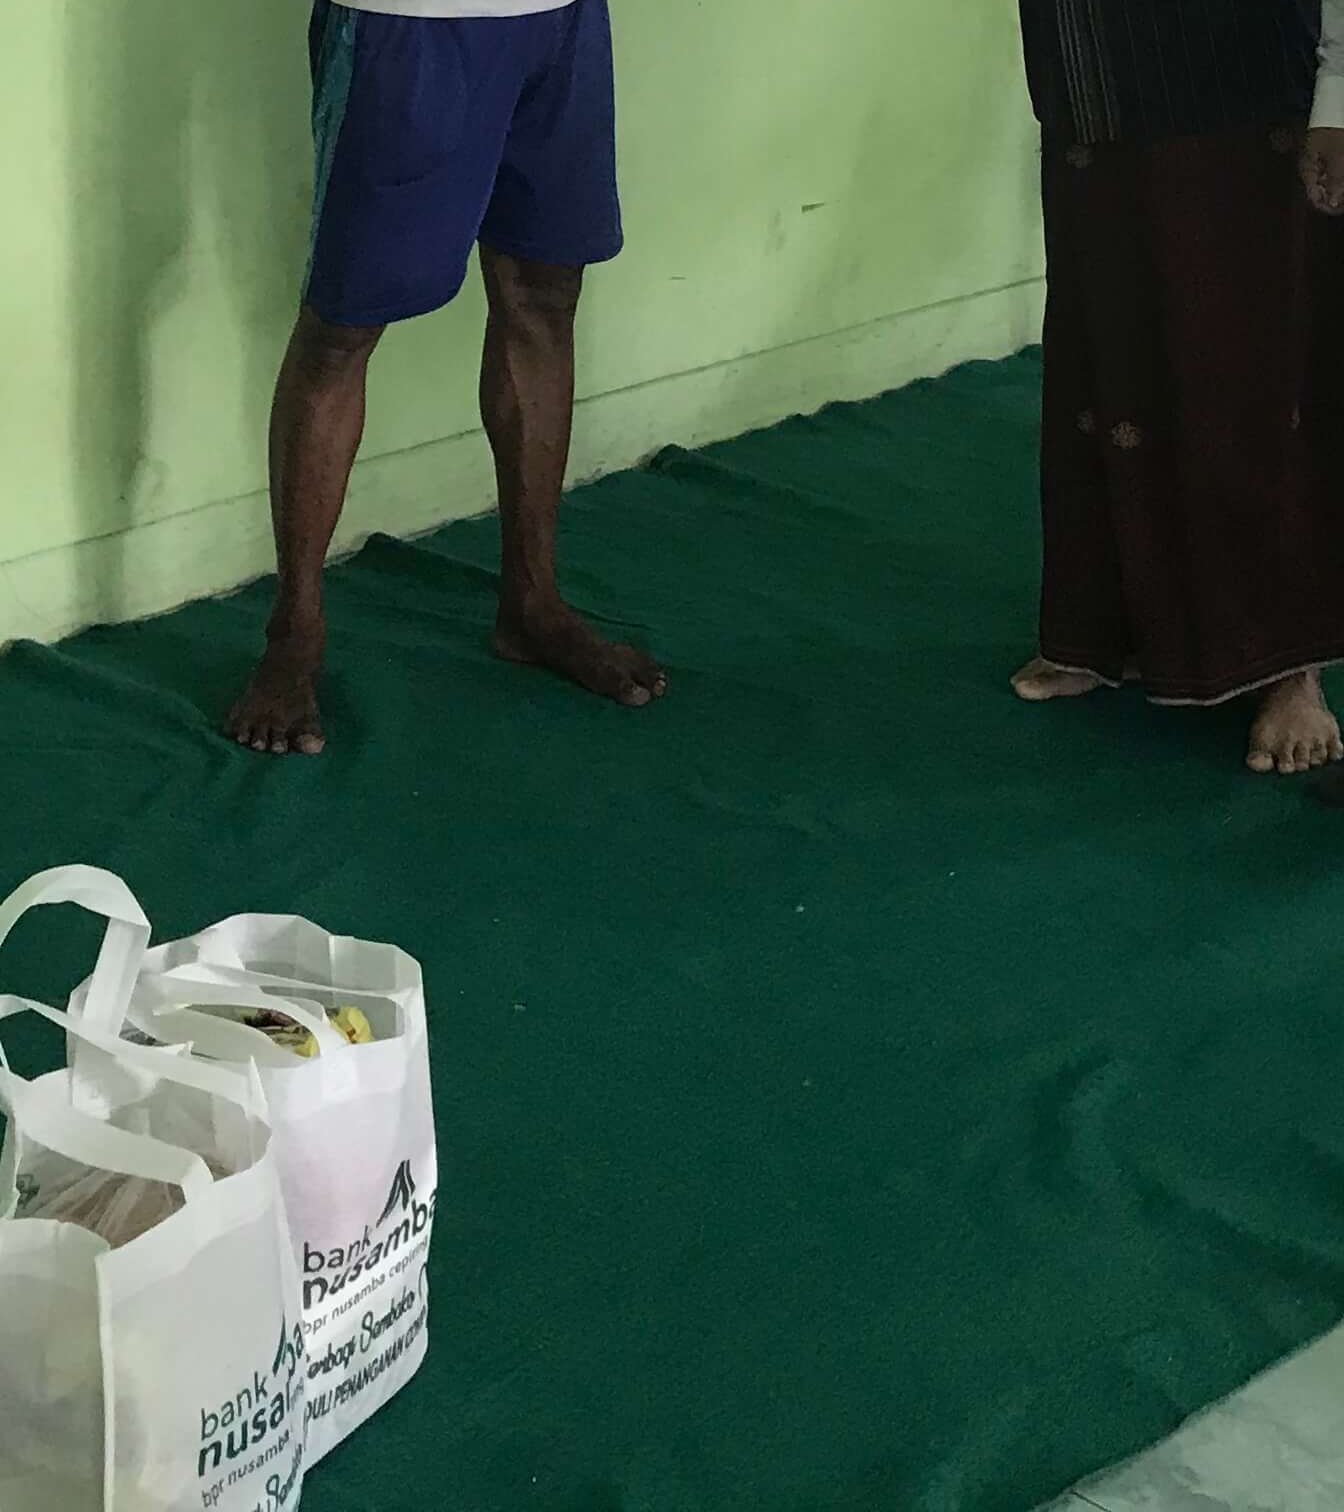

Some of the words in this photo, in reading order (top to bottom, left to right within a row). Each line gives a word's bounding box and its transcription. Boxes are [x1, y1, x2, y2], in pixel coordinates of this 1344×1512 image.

[303, 1224, 371, 1274] bank
[331, 1273, 386, 1318] nusamba
[306, 1335, 356, 1379] erbagi
[201, 1371, 268, 1440] bank
[202, 1478, 224, 1508] bpr
